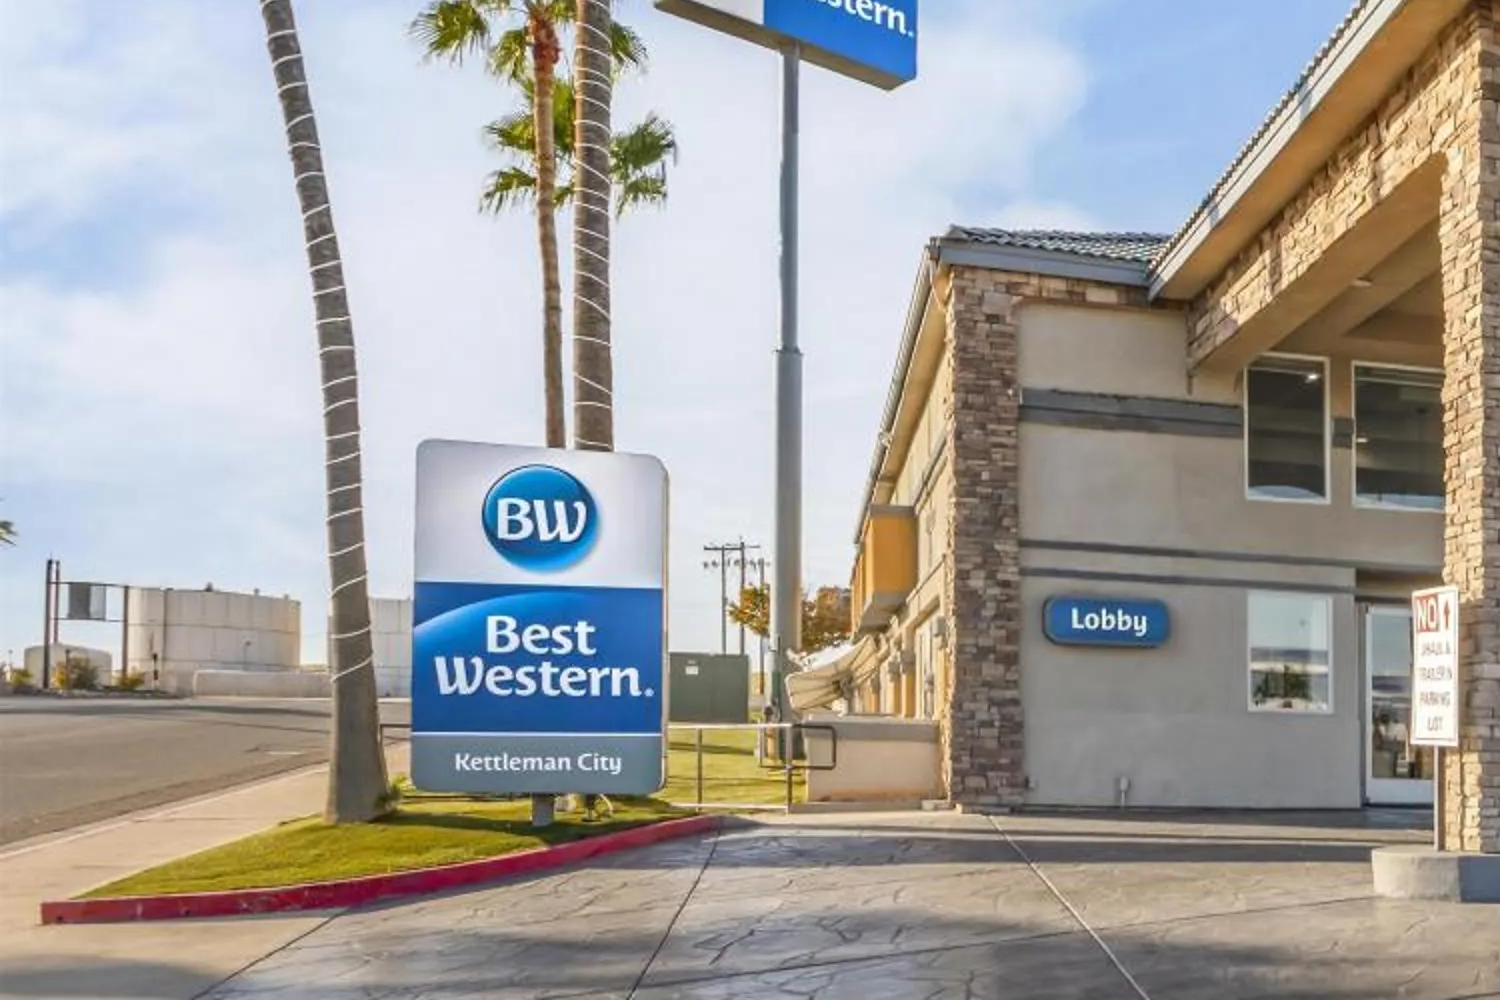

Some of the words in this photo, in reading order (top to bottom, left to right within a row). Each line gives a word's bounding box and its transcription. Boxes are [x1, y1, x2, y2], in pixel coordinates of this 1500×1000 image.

[497, 497, 588, 542] BW
[1071, 606, 1148, 637] Lobby
[1417, 597, 1437, 630] NO
[486, 615, 597, 656] Best
[1427, 716, 1443, 732] LOT
[455, 752, 574, 772] Kettleman
[577, 752, 622, 775] City
